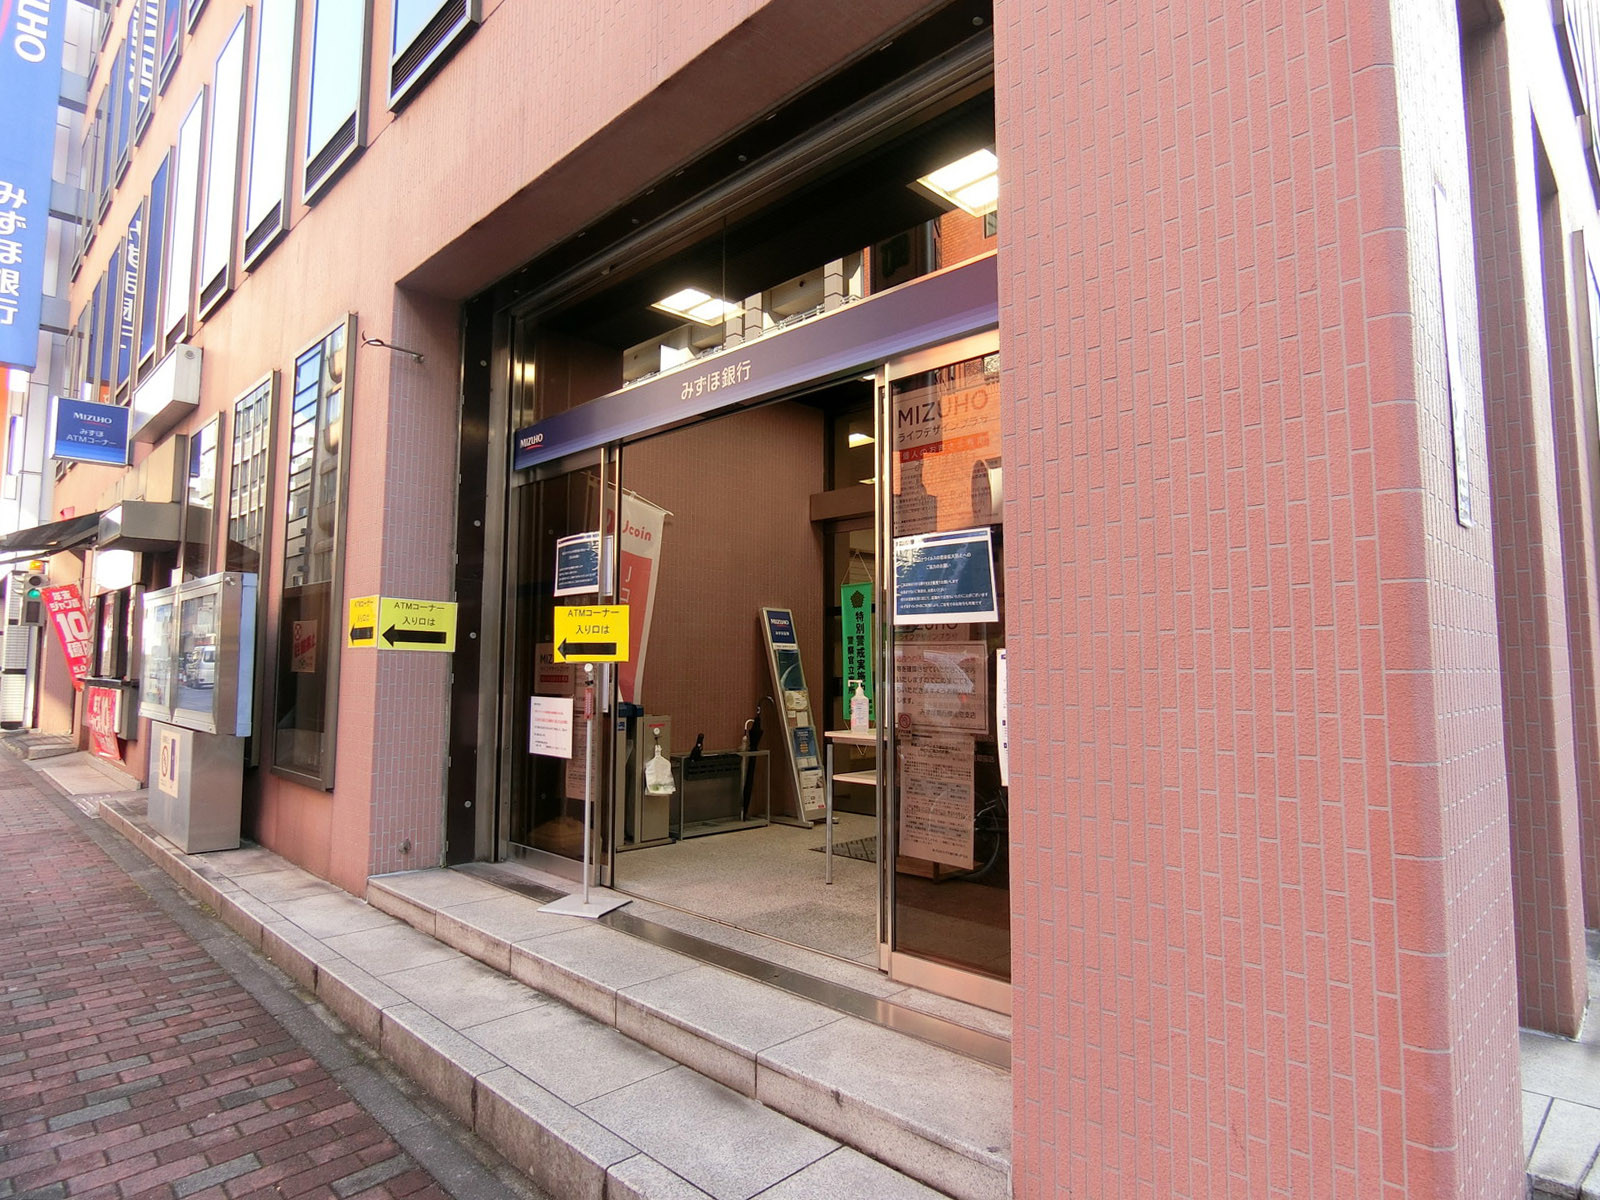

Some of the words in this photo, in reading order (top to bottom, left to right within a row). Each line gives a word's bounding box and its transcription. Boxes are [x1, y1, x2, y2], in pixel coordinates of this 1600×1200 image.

[681, 360, 752, 400] みずほ銀行
[898, 389, 988, 428] MIZUHO
[73, 412, 112, 424] MIZUHO
[80, 429, 104, 437] みずほ
[66, 434, 117, 445] ATMコーナー
[520, 433, 543, 448] MIZUHO
[394, 602, 445, 612] ATMコーナー
[568, 608, 620, 617] ATMコーナー
[402, 616, 436, 626] 入り口は
[56, 611, 88, 643] 10
[576, 625, 610, 634] 入り口は
[855, 611, 866, 692] 特別警戒実施
